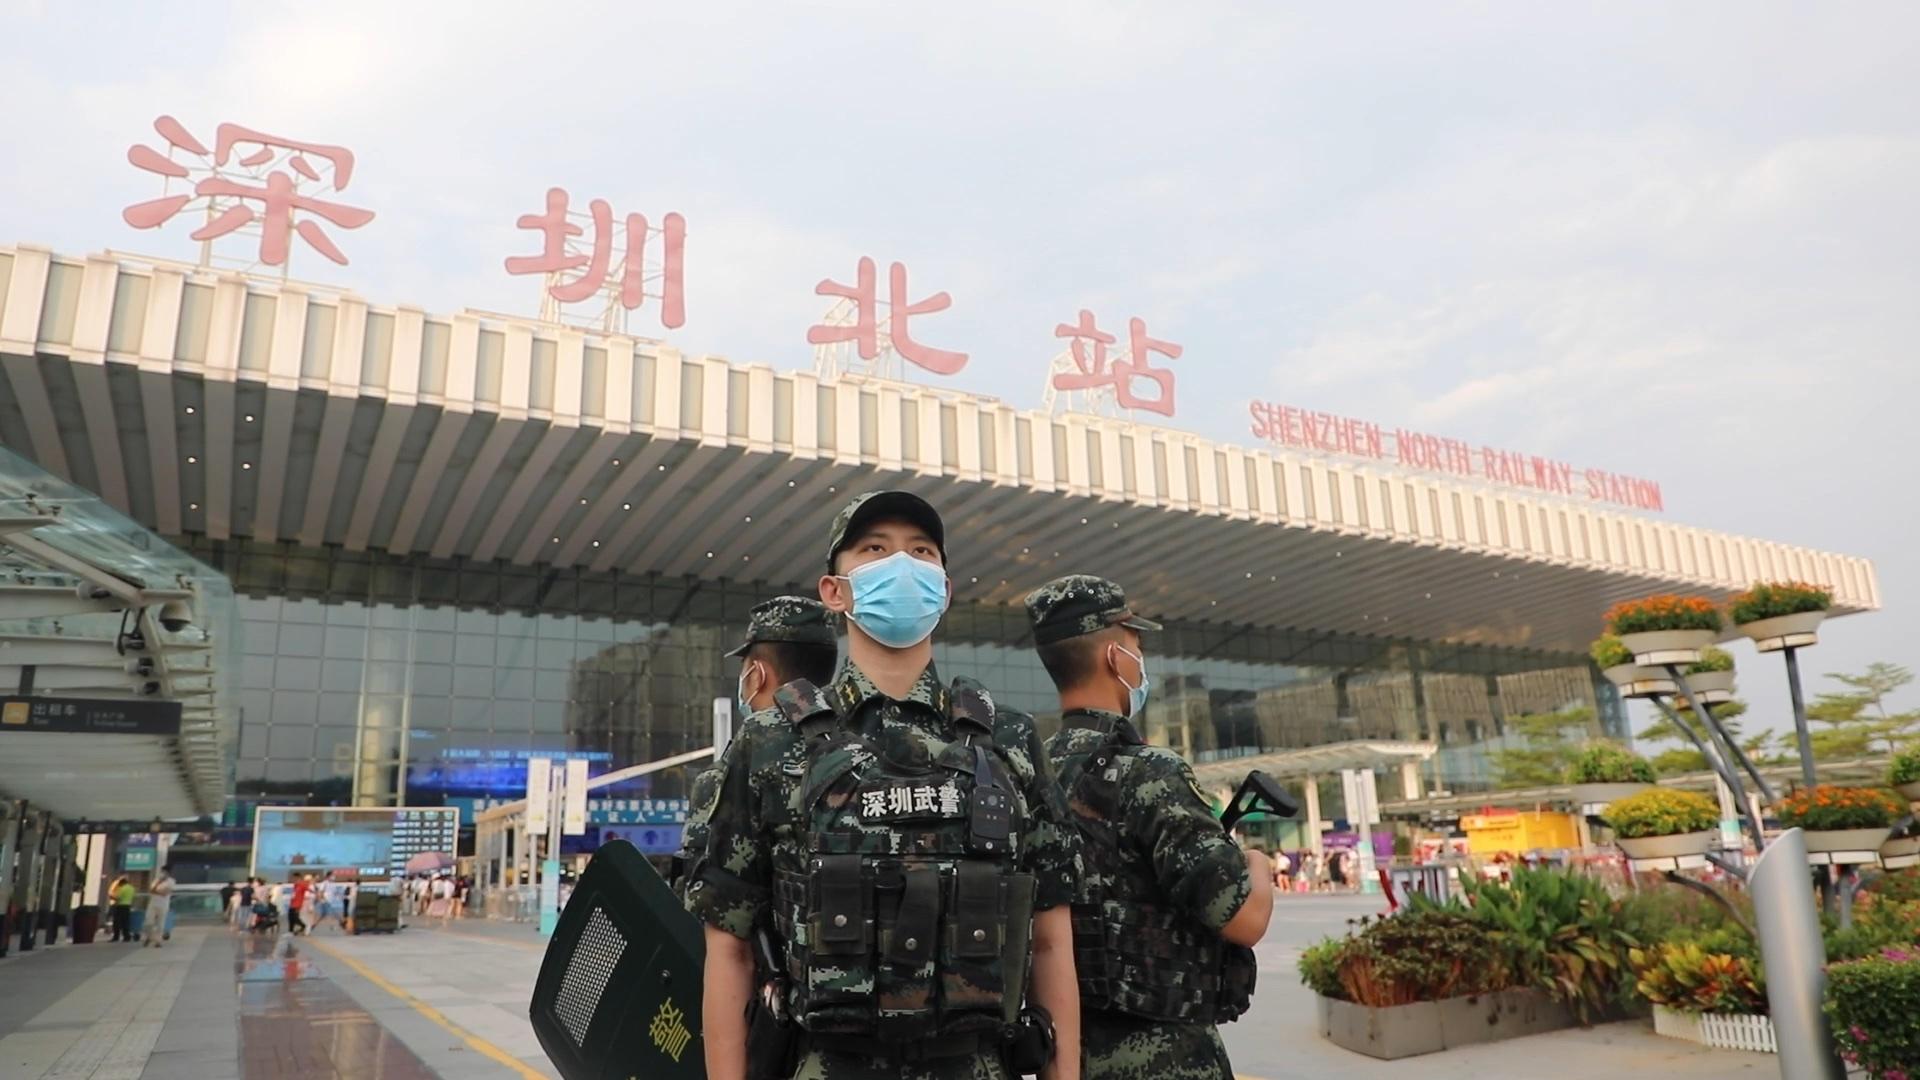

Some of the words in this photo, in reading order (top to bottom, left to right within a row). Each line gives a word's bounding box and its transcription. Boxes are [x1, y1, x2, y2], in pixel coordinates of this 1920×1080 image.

[123, 115, 1184, 417] 深圳北站
[1249, 400, 1382, 459] SHENZHEN
[1396, 428, 1472, 476] NORTH
[1483, 446, 1573, 495] RAILWAY
[1584, 468, 1664, 512] STATION
[862, 782, 960, 818] 深圳武警
[649, 996, 692, 1062] 警
